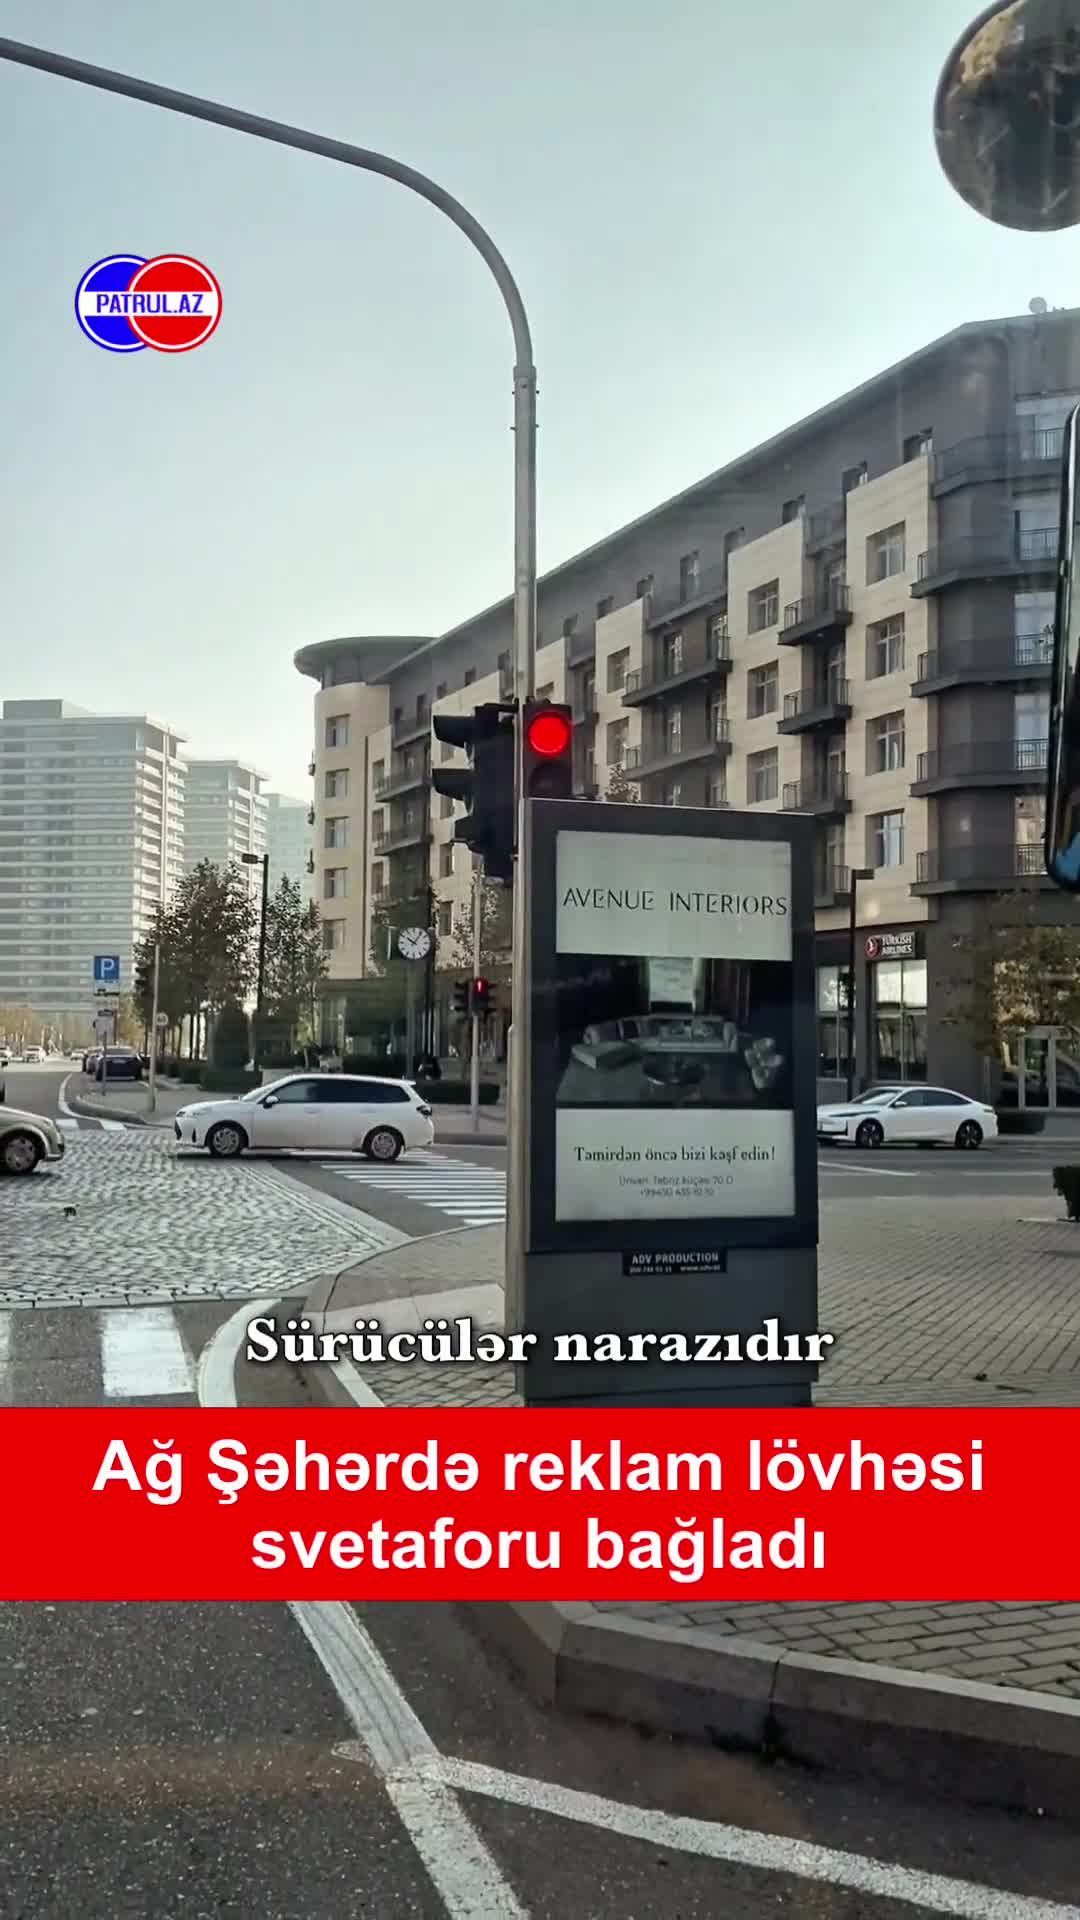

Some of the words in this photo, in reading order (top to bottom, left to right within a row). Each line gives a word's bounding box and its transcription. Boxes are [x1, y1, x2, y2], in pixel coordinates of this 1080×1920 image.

[563, 888, 655, 911] AVENUE
[669, 890, 788, 916] INTERIORS
[881, 935, 912, 947] TURKISH
[101, 958, 115, 979] P
[574, 1146, 641, 1161] Təmirdən
[645, 1147, 678, 1161] öncə
[681, 1146, 706, 1161] bizi
[710, 1146, 738, 1164] kəşf
[740, 1146, 776, 1161] edin!
[631, 1254, 652, 1265] ADV
[655, 1252, 719, 1264] PRODUCTION
